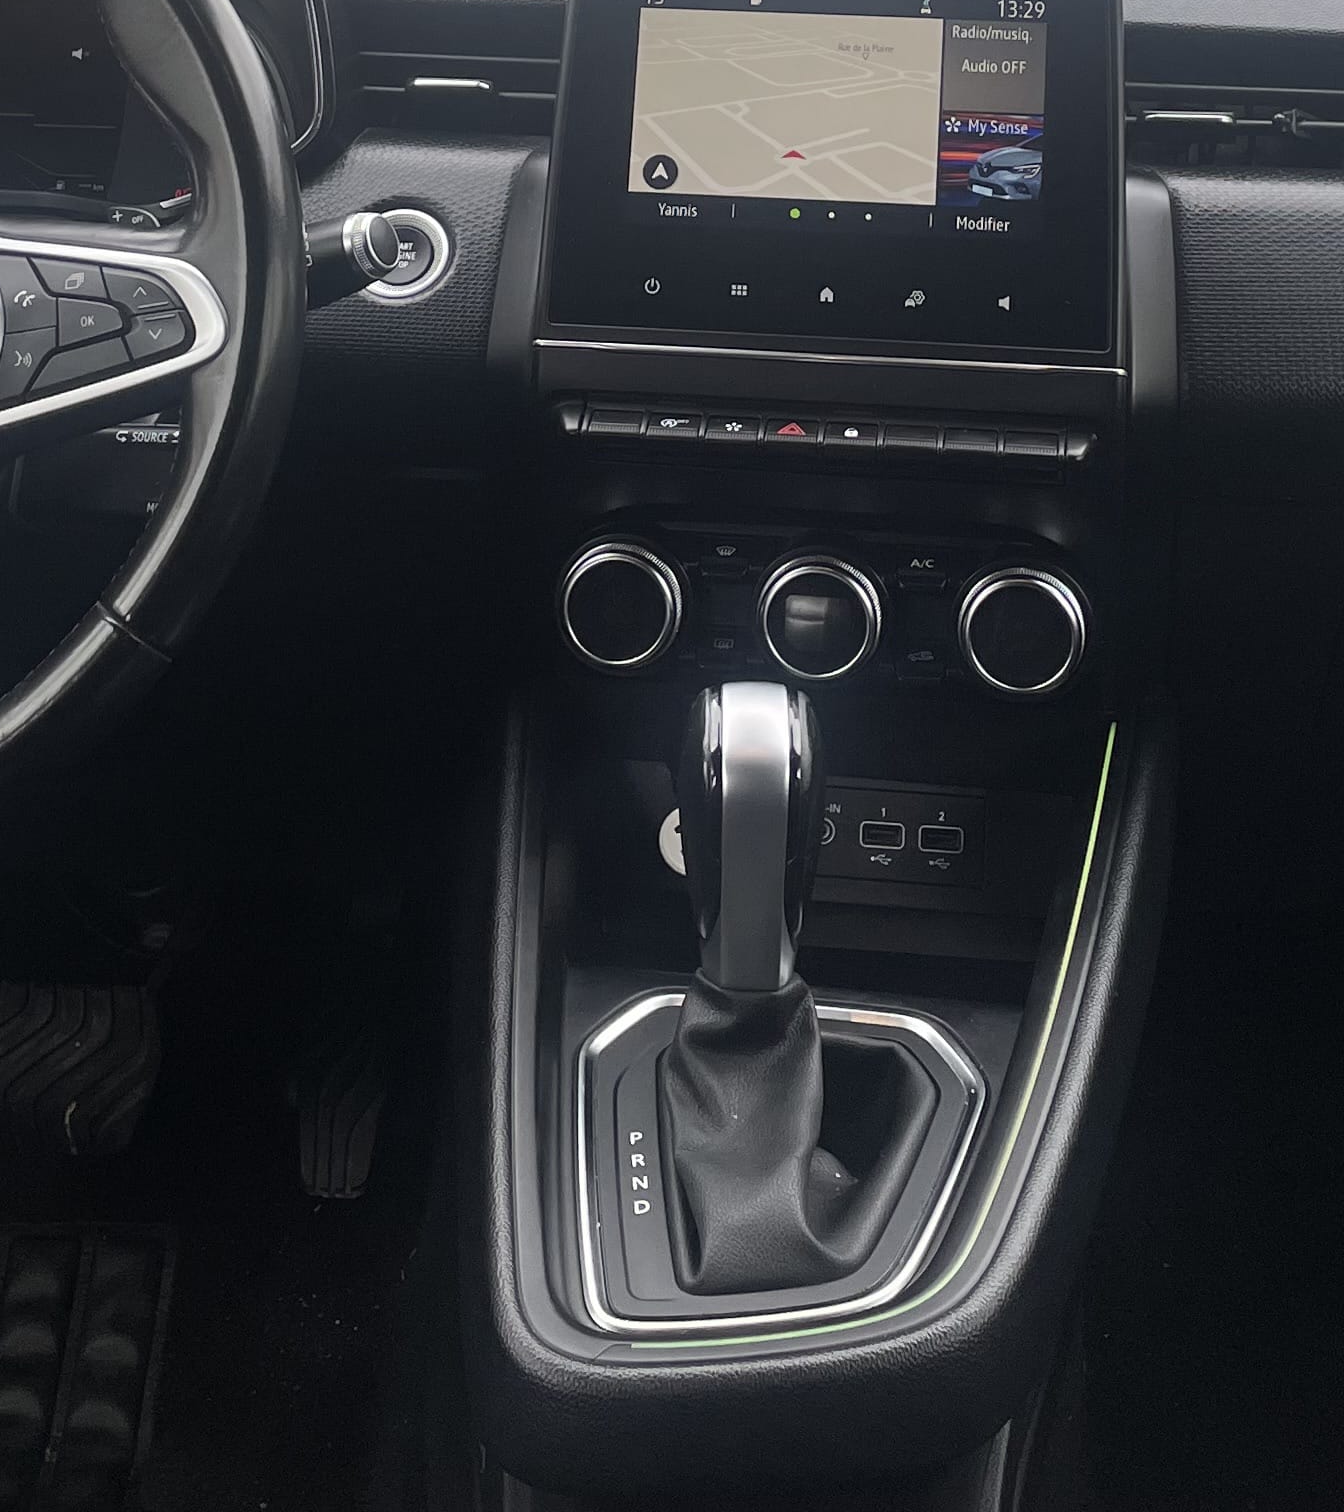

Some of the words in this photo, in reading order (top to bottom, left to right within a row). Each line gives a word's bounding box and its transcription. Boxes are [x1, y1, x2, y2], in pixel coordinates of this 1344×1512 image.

[996, 0, 1046, 20] 13:29
[951, 25, 1034, 43] Radio/musiq.
[961, 58, 998, 75] Audio
[1000, 60, 1027, 76] OFF
[967, 118, 986, 136] My
[987, 119, 1029, 135] Sense
[658, 202, 698, 218] Yannis
[955, 215, 1011, 233] Modifier
[79, 314, 96, 329] OK
[131, 431, 169, 443] SOURCE
[910, 557, 935, 570] A/C
[881, 808, 886, 817] 1
[939, 812, 945, 821] 2
[630, 1132, 643, 1145] P
[631, 1154, 646, 1167] R
[632, 1176, 648, 1190] N
[633, 1200, 650, 1214] D
